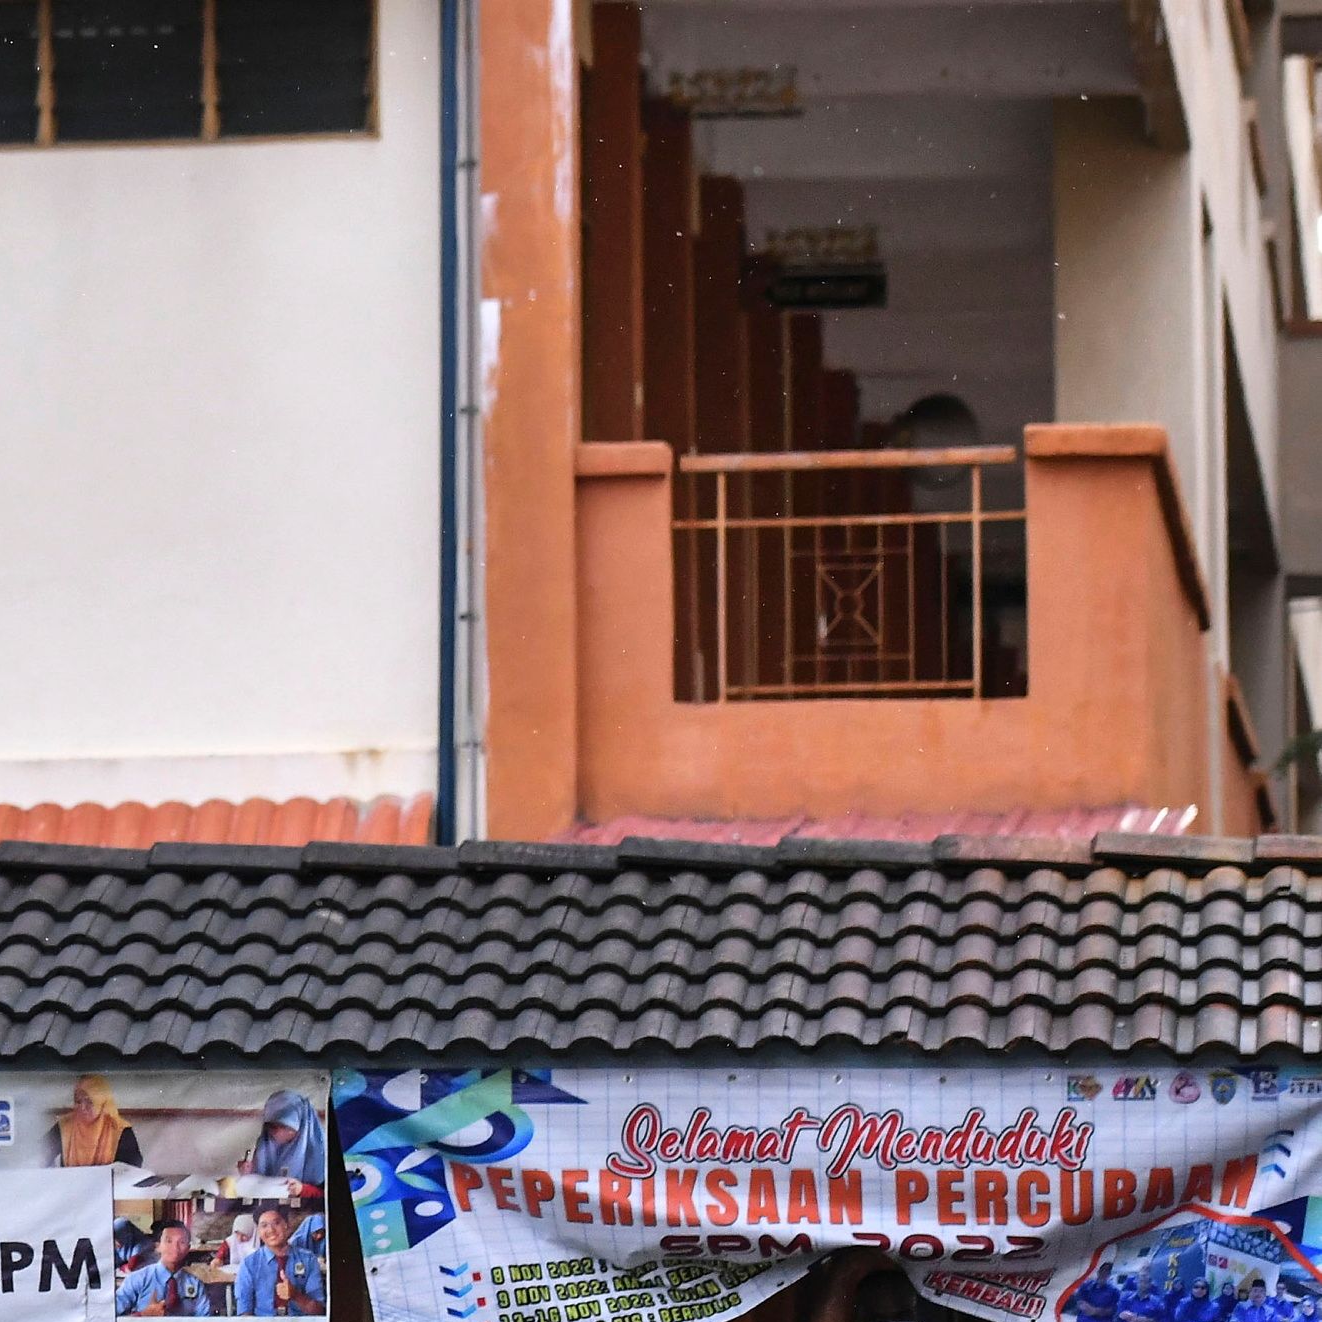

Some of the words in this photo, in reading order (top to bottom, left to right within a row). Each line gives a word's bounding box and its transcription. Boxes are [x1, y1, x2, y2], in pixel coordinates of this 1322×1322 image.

[608, 1103, 821, 1178] Selamat
[818, 1103, 1093, 1179] Menduduki
[446, 1160, 865, 1228] PEPERIKSAAN
[896, 1153, 1259, 1227] PERCUBAAN
[659, 1232, 814, 1259] SPM
[491, 1266, 504, 1285] 8
[510, 1262, 543, 1282] NOV
[547, 1257, 595, 1280] 2022
[496, 1290, 509, 1309] 9
[515, 1286, 552, 1306] NOV
[566, 1301, 601, 1322] NOV
[607, 1293, 655, 1313] 2022
